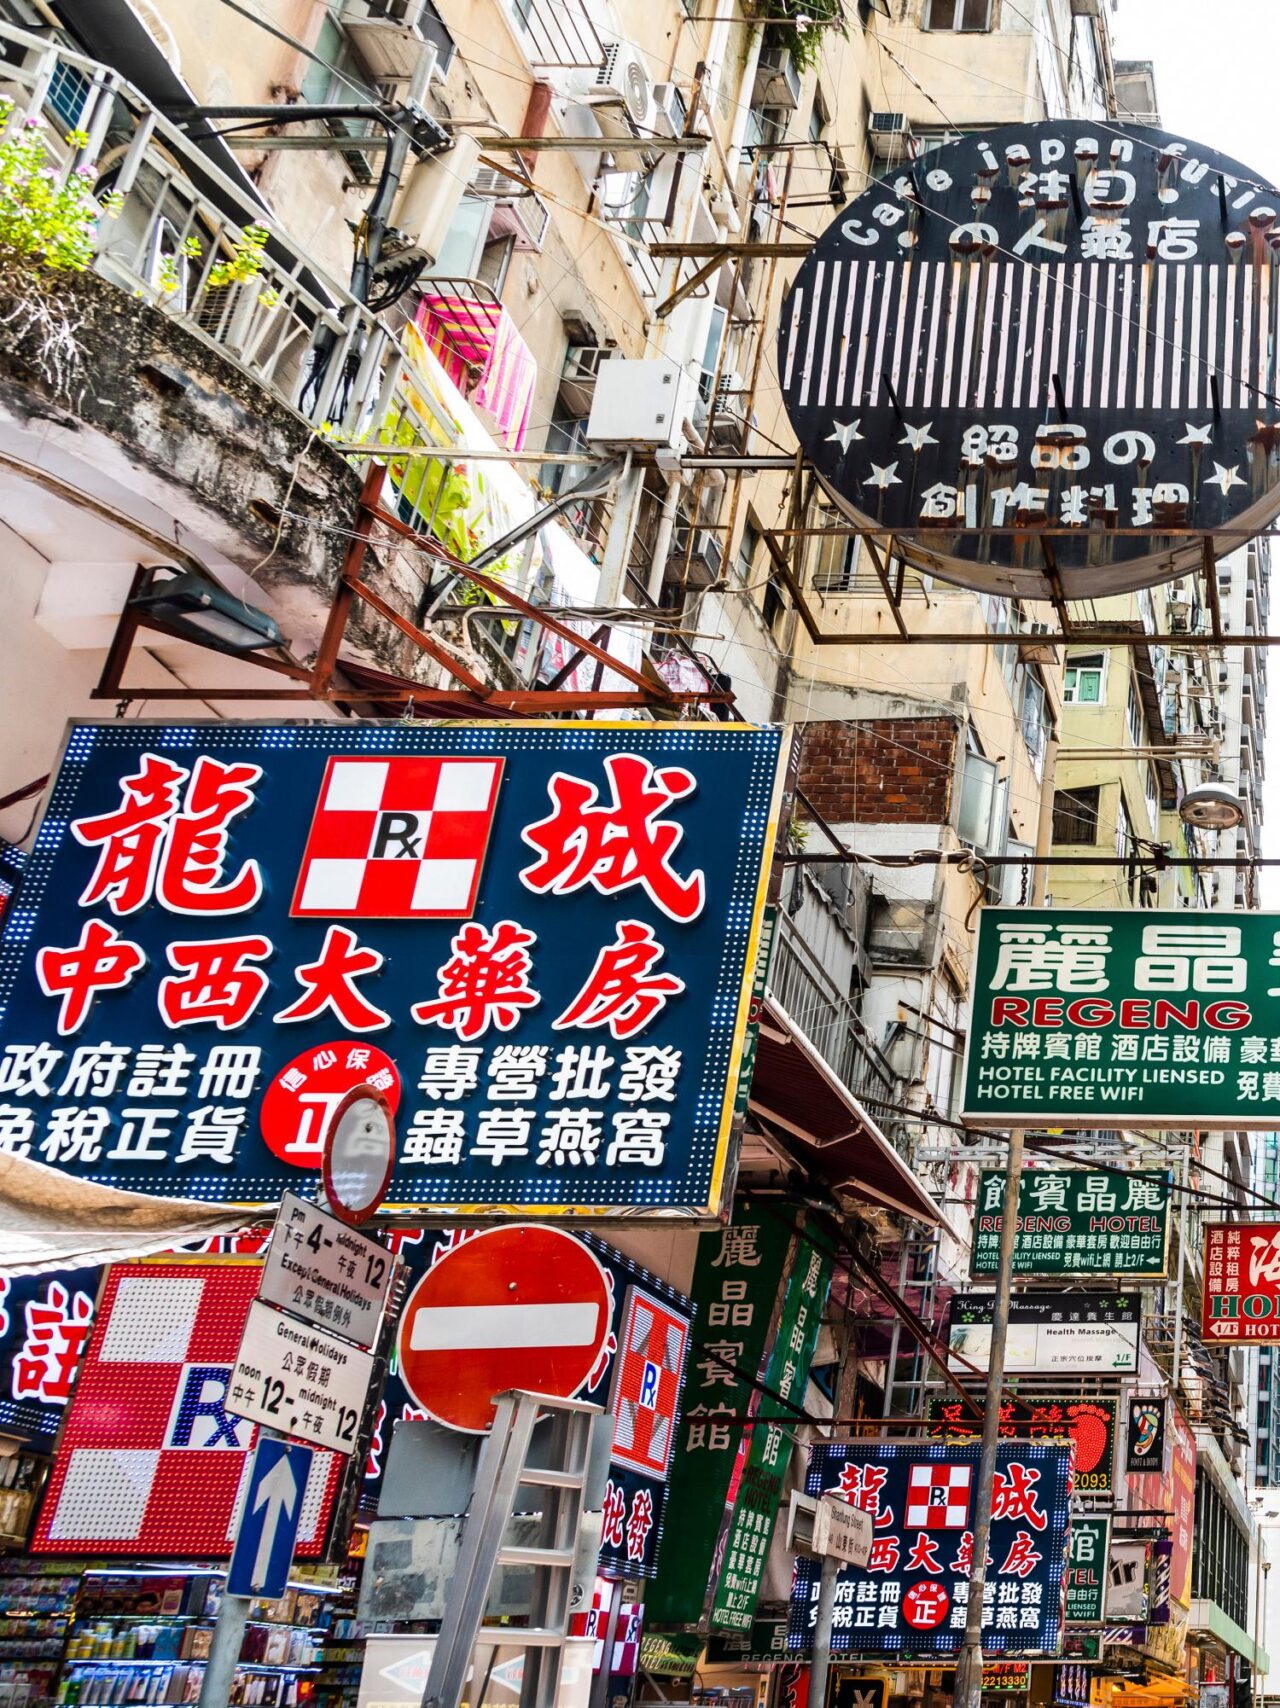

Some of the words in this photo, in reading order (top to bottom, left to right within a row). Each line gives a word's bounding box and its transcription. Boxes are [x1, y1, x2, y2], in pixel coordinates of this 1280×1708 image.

[841, 168, 954, 246] Cafe
[977, 137, 1133, 178] japan
[71, 753, 264, 916] 龍
[520, 753, 706, 923] 城
[36, 919, 686, 1041] 中西大藥房
[990, 996, 1253, 1031] REGENG
[981, 1031, 1102, 1062] 持牌賓館
[1111, 1033, 1232, 1064] 酒店設備
[417, 1045, 682, 1102] 專營批發
[979, 1067, 1045, 1081] HOTEL
[1050, 1067, 1138, 1082] FACILITY
[1142, 1069, 1225, 1084] LIENSED
[977, 1085, 1043, 1100] HOTEL
[1048, 1086, 1095, 1100] FREE
[1099, 1087, 1143, 1101] WIFI
[401, 1109, 664, 1167] 蟲草燕窩
[1089, 1216, 1162, 1232] HOTEL
[291, 1207, 305, 1224] pm
[364, 1254, 385, 1289] 12
[338, 1255, 358, 1280] 午夜
[340, 1284, 372, 1311] Holidays
[277, 1322, 310, 1349] General
[1046, 1328, 1075, 1336] Health
[1078, 1328, 1116, 1336] Massage
[232, 1383, 255, 1409] 中午
[302, 1410, 324, 1435] 午夜
[238, 1362, 261, 1381] noon
[299, 1387, 337, 1411] midnight
[335, 1406, 358, 1443] 12
[1074, 1473, 1107, 1488] 2093
[912, 1600, 938, 1624] 正
